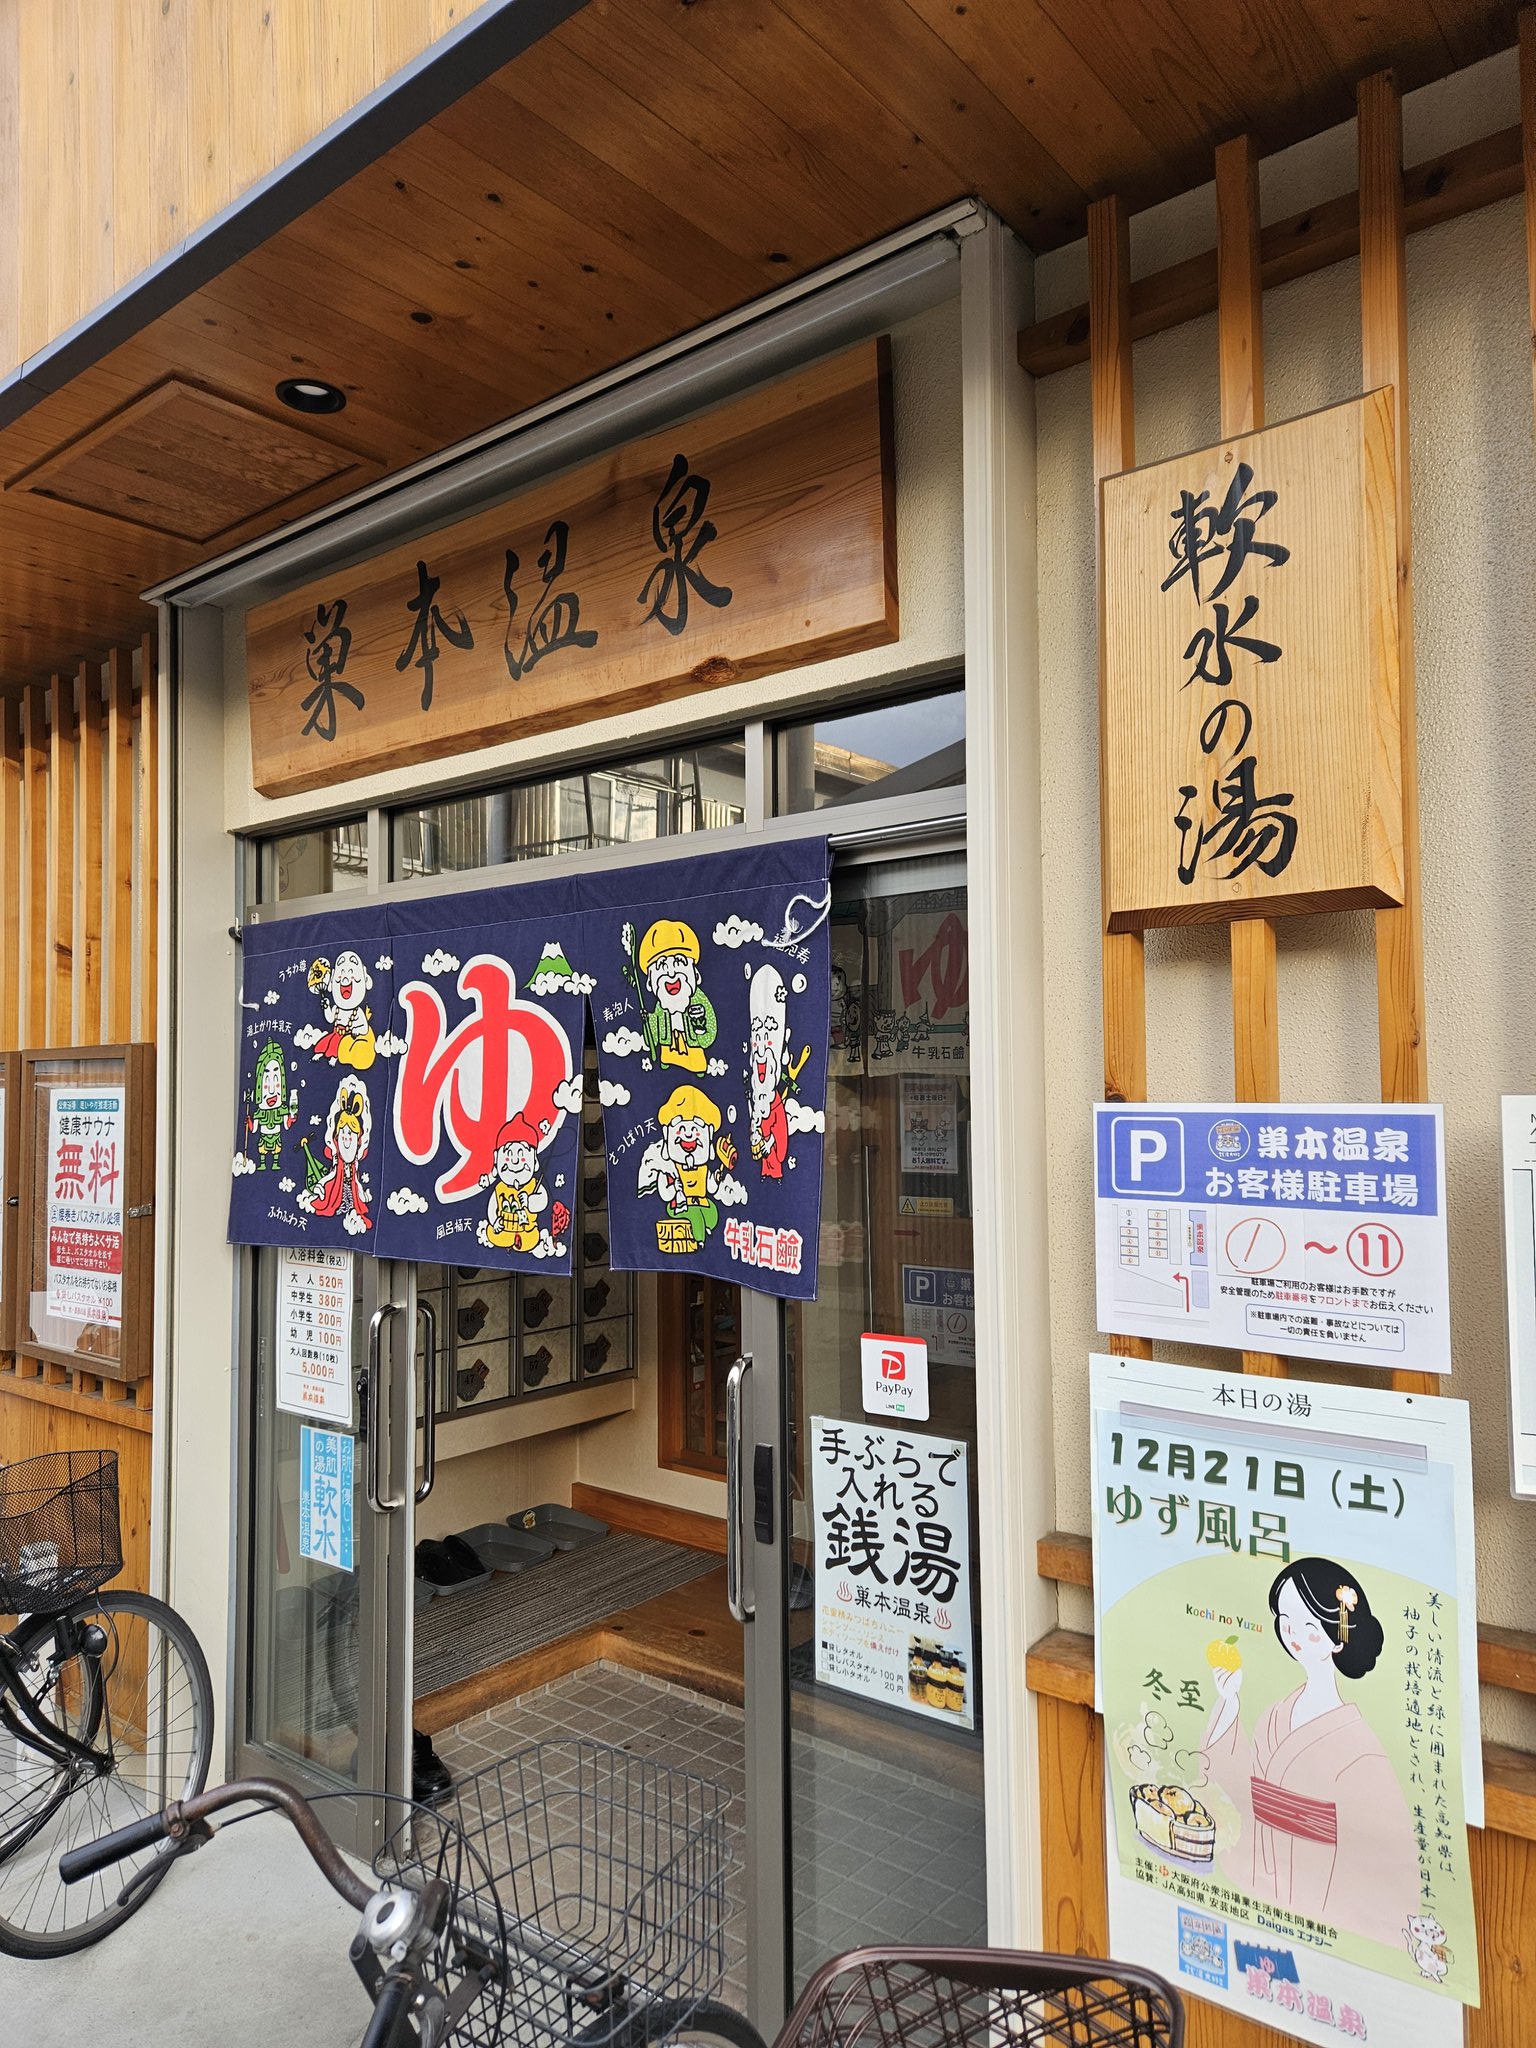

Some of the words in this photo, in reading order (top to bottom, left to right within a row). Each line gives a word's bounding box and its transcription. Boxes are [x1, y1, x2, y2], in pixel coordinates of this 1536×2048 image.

[300, 453, 733, 742] 巣本温泉
[1160, 461, 1299, 885] 軟水の湯
[278, 959, 308, 983] うちわ尊
[602, 997, 635, 1023] 寿泡人
[395, 958, 571, 1202] ゆ
[59, 1114, 116, 1137] 健康サウナ
[608, 1116, 658, 1166] さっぱり天
[1256, 1126, 1410, 1164] 巣本温泉
[54, 1137, 120, 1206] 無料
[1130, 1129, 1167, 1182] P
[1205, 1166, 1420, 1208] お客様駐車場
[267, 1205, 309, 1232] ふわふわ天
[290, 1290, 313, 1304] 中学生
[318, 1293, 343, 1309] 380円
[318, 1275, 344, 1289] 520円
[290, 1309, 313, 1323] 小学生
[318, 1312, 342, 1328] 200円
[318, 1331, 342, 1346] 100円
[301, 1361, 335, 1379] 5,000円
[875, 1380, 914, 1399] PayPay
[1211, 1383, 1313, 1418] 本日の湯
[818, 1427, 963, 1488] 手ぶらで
[835, 1466, 941, 1519] 入れる
[312, 1475, 338, 1560] 軟水
[1106, 1483, 1291, 1564] ゆず風呂
[821, 1502, 962, 1605] 銭湯
[854, 1584, 932, 1626] 巣本温泉
[1218, 1613, 1233, 1626] no
[1236, 1616, 1263, 1634] Yuzu
[1141, 1667, 1205, 1713] 冬至
[1208, 1895, 1251, 1921] 安芸地区
[1256, 1913, 1295, 1938] Daigas
[1245, 1965, 1368, 2041] 巣本温泉
